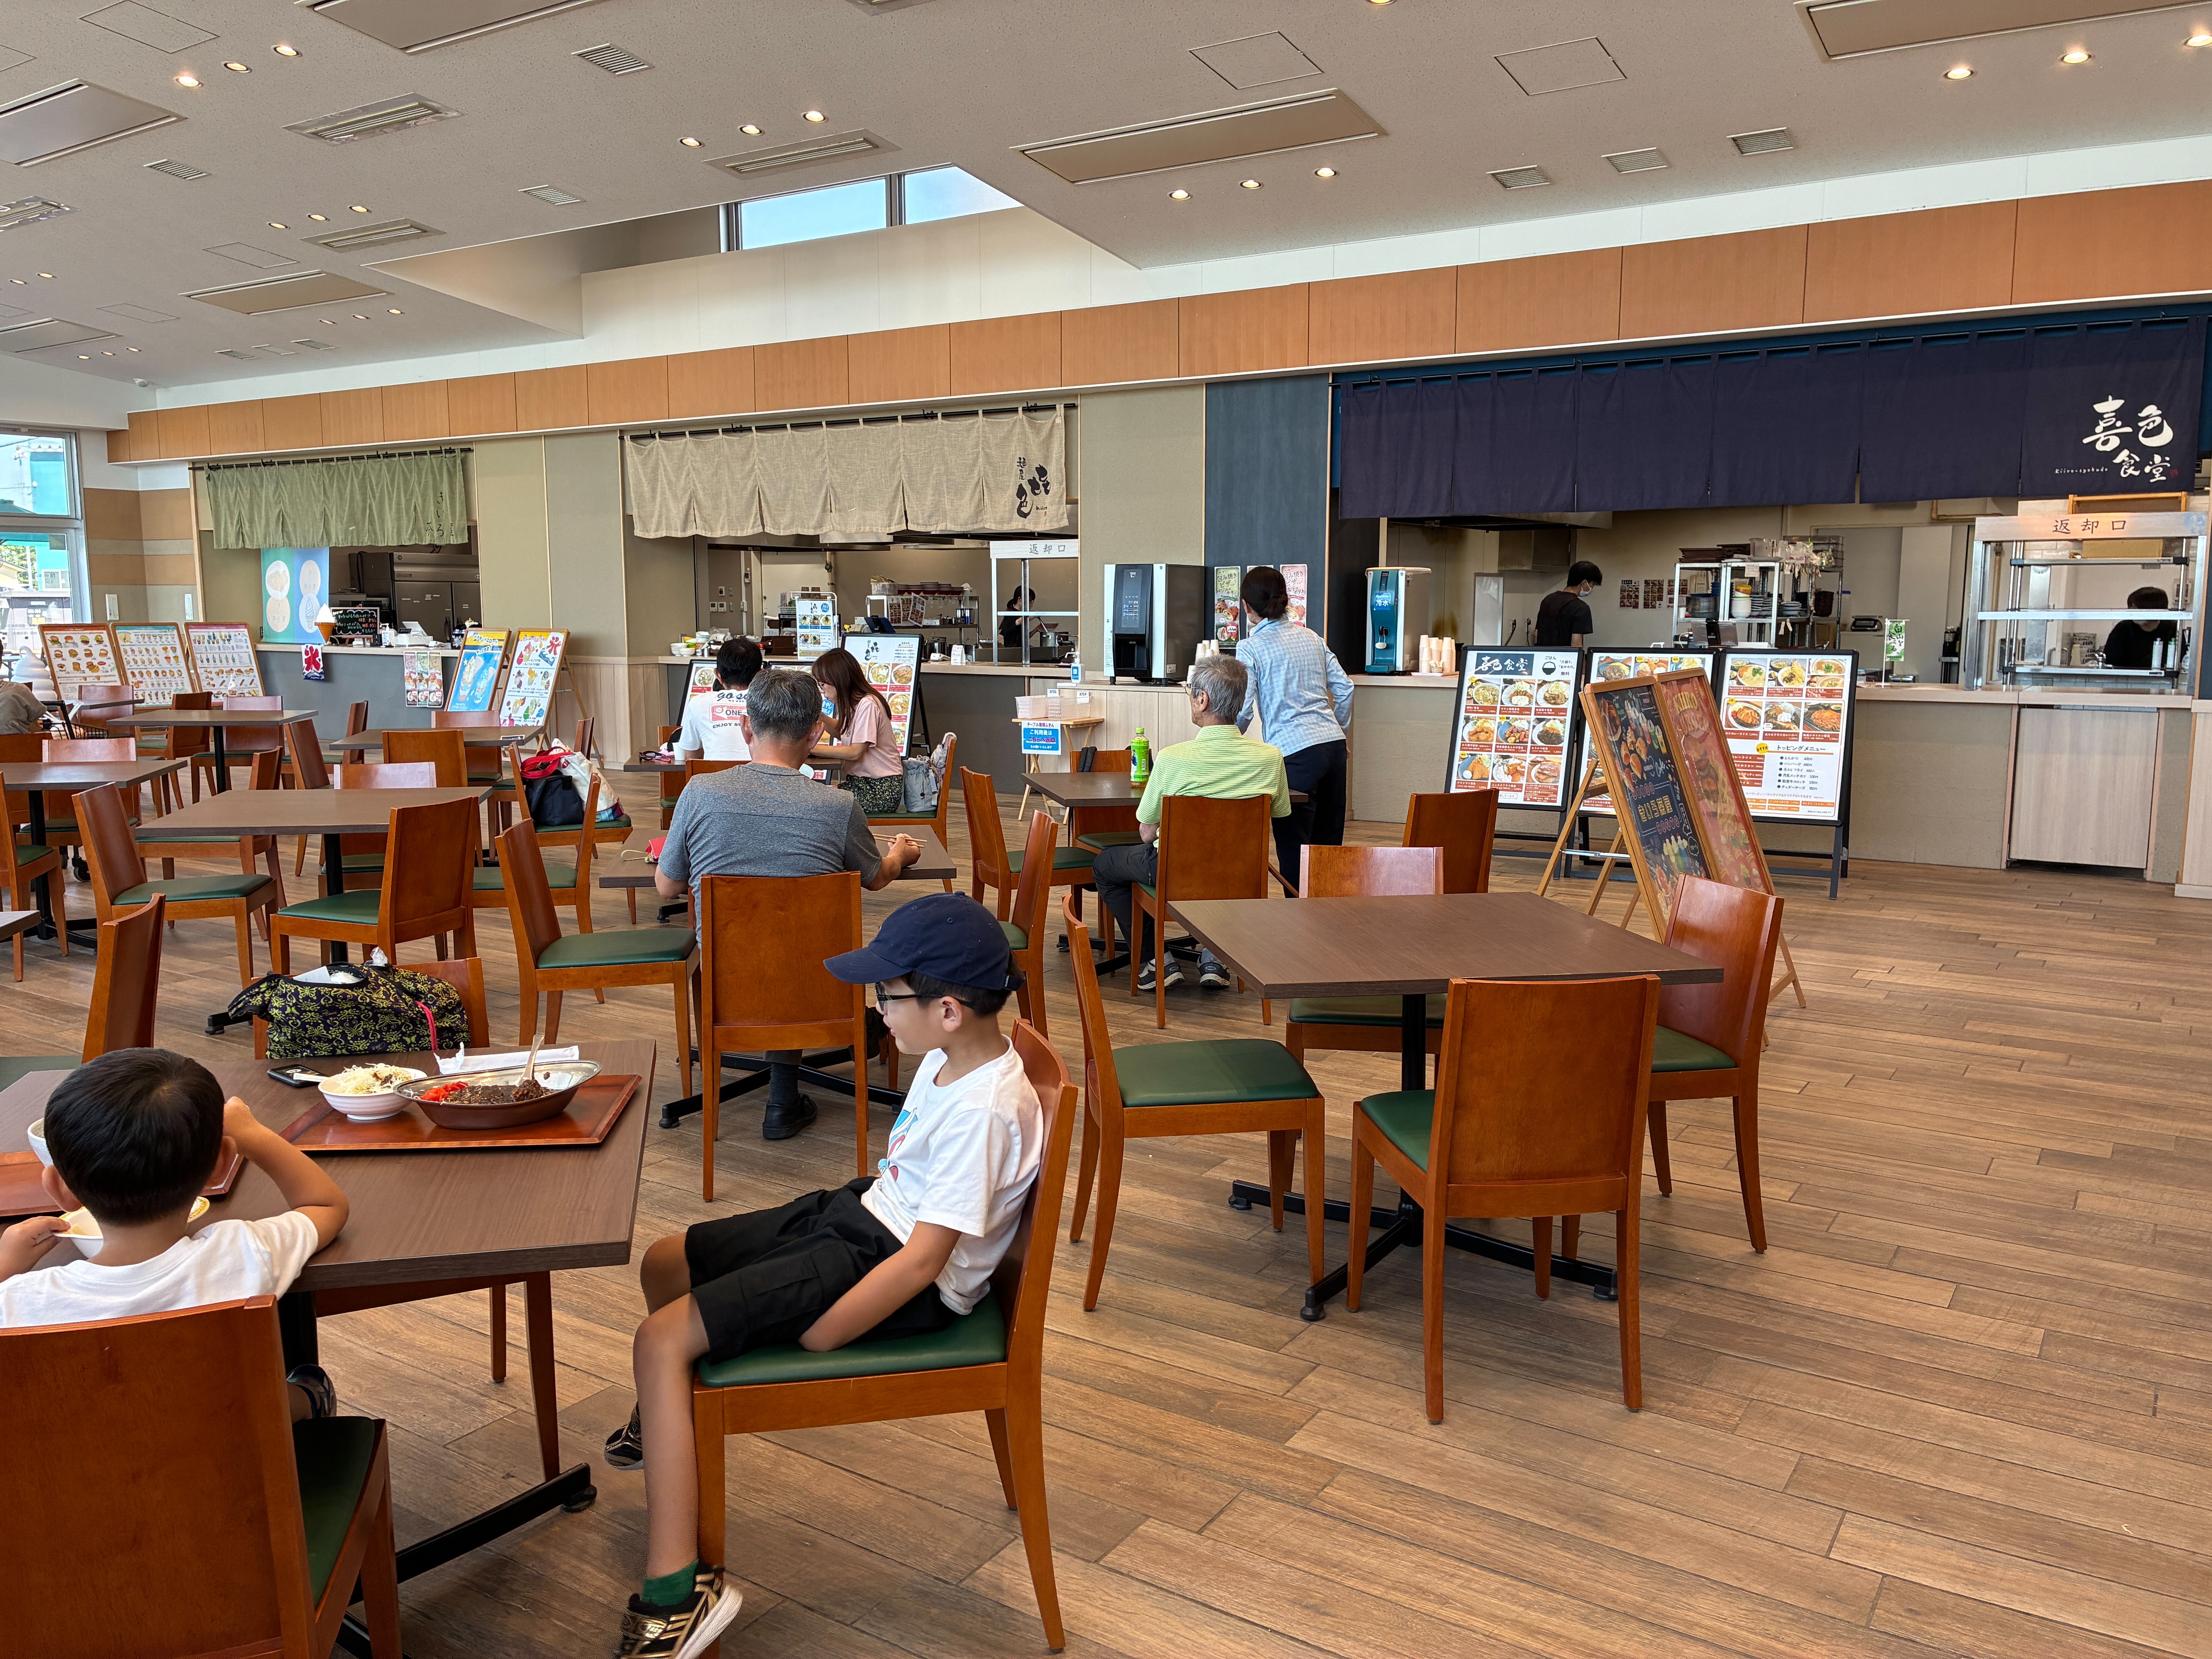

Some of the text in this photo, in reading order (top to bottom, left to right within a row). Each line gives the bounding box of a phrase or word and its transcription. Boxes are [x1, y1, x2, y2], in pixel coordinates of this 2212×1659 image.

[2082, 395, 2173, 452] 喜色
[2112, 448, 2171, 483] 食堂
[2052, 518, 2128, 534] 返却口
[1029, 543, 1066, 555] 返却口
[1217, 572, 1237, 582] 包み焼き
[1220, 580, 1231, 588] ピザ
[546, 635, 562, 656] 氷
[304, 644, 321, 672] 氷
[1481, 655, 1528, 672] 喜色食堂
[717, 692, 735, 702] go
[1638, 795, 1673, 822] きいろ茶屋
